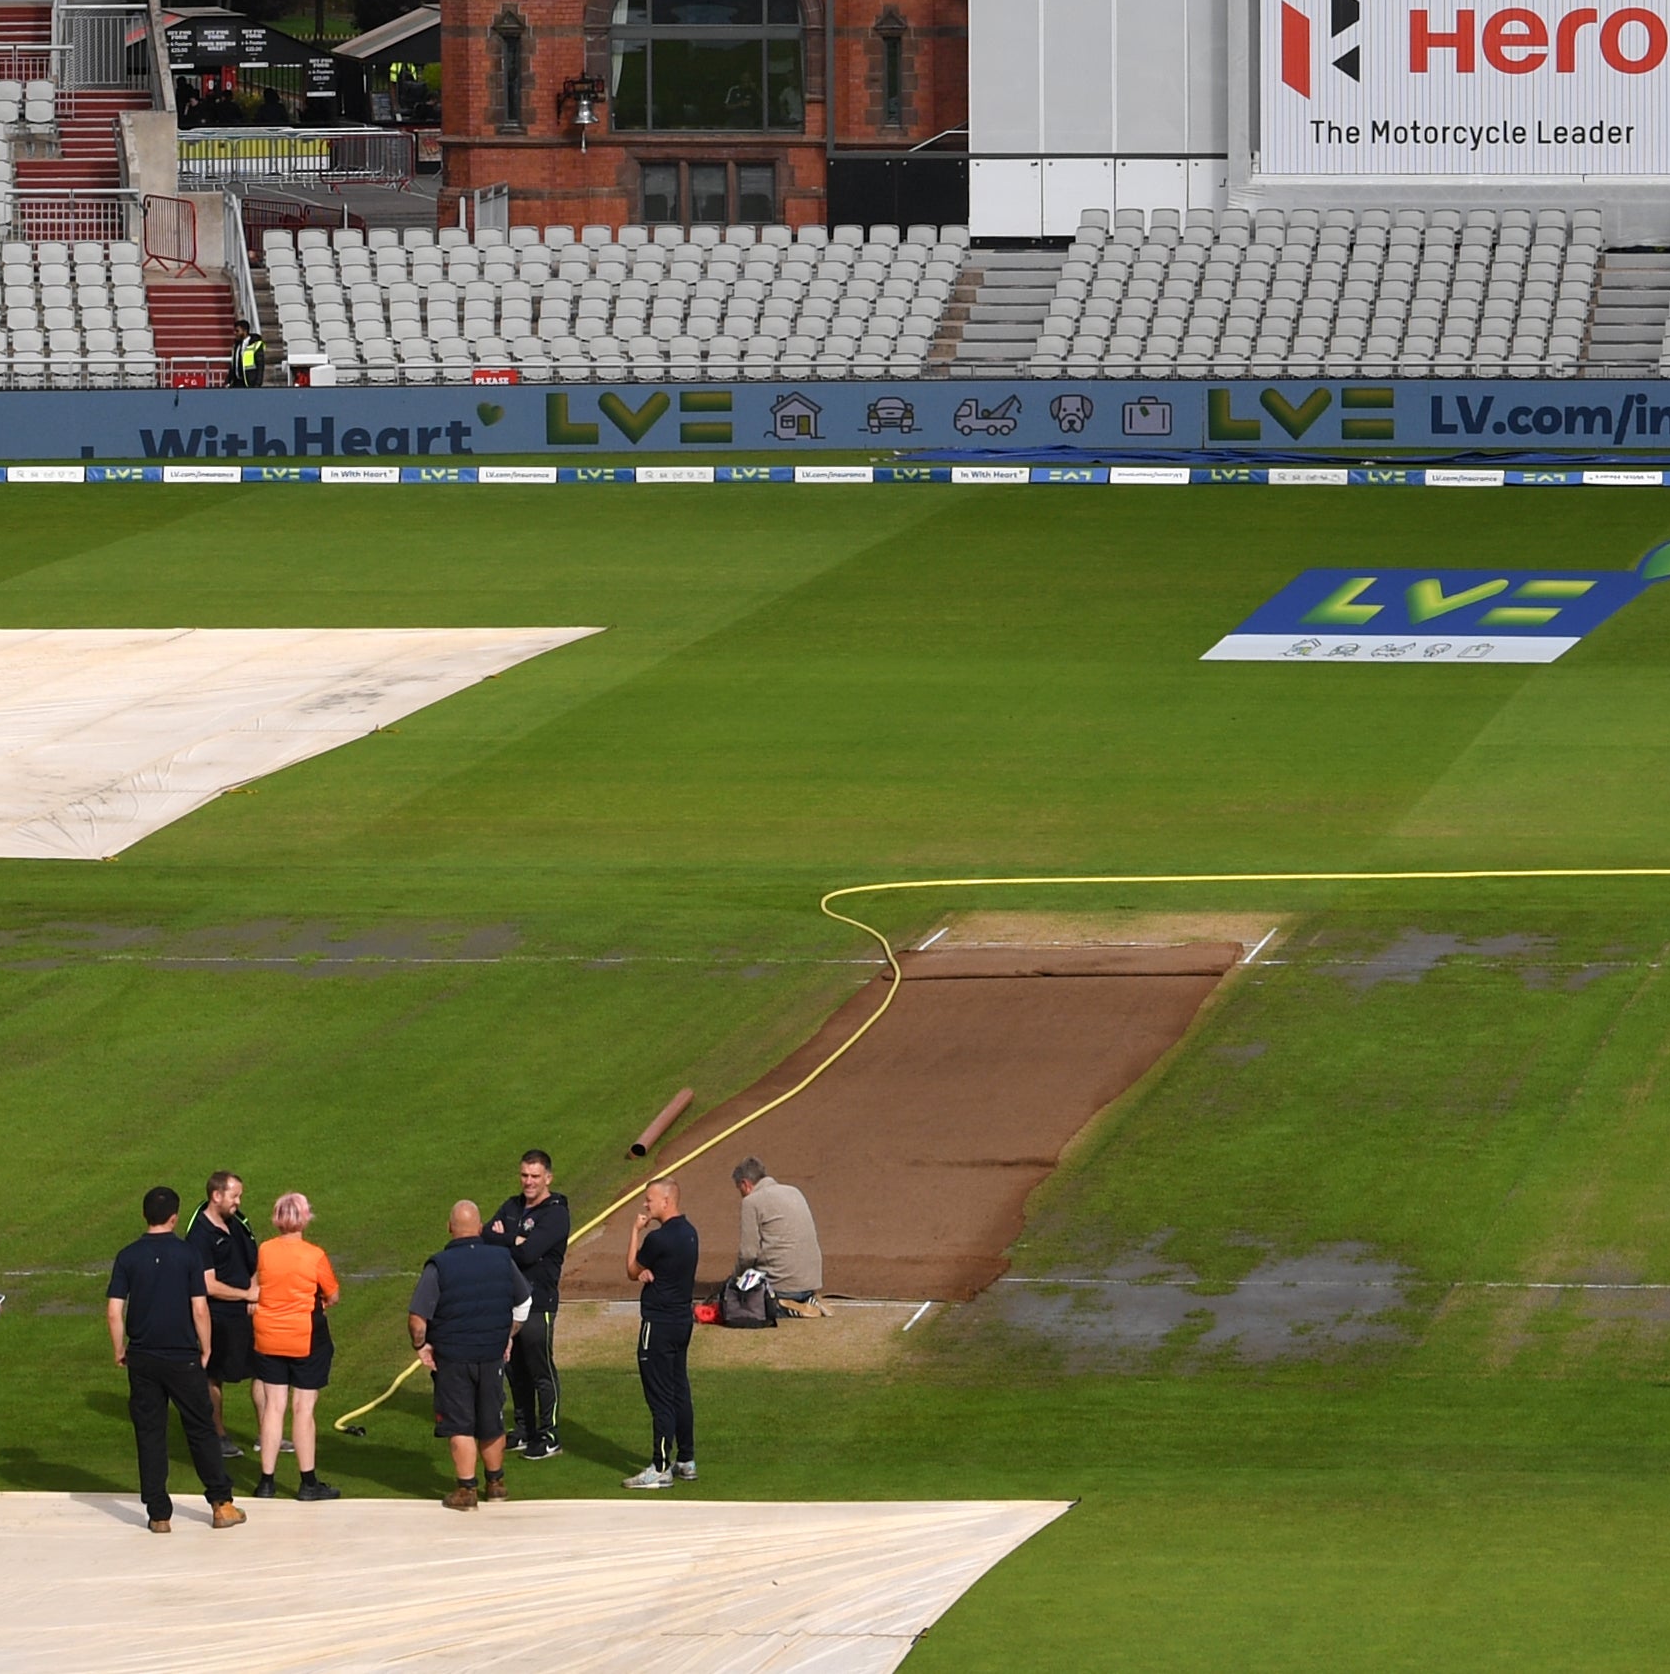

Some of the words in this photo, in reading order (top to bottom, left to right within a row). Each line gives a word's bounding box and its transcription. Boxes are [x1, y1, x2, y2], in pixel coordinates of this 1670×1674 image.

[1409, 7, 1669, 74] Hero
[1310, 120, 1360, 144] The
[1371, 120, 1527, 151] Motorcycle
[1537, 120, 1635, 144] Leader
[475, 377, 510, 385] PLEASE
[330, 470, 337, 478] In
[339, 470, 359, 478] With
[361, 470, 387, 478] Heart
[960, 471, 968, 479] In
[970, 471, 990, 479] With
[992, 471, 1017, 479] Heart
